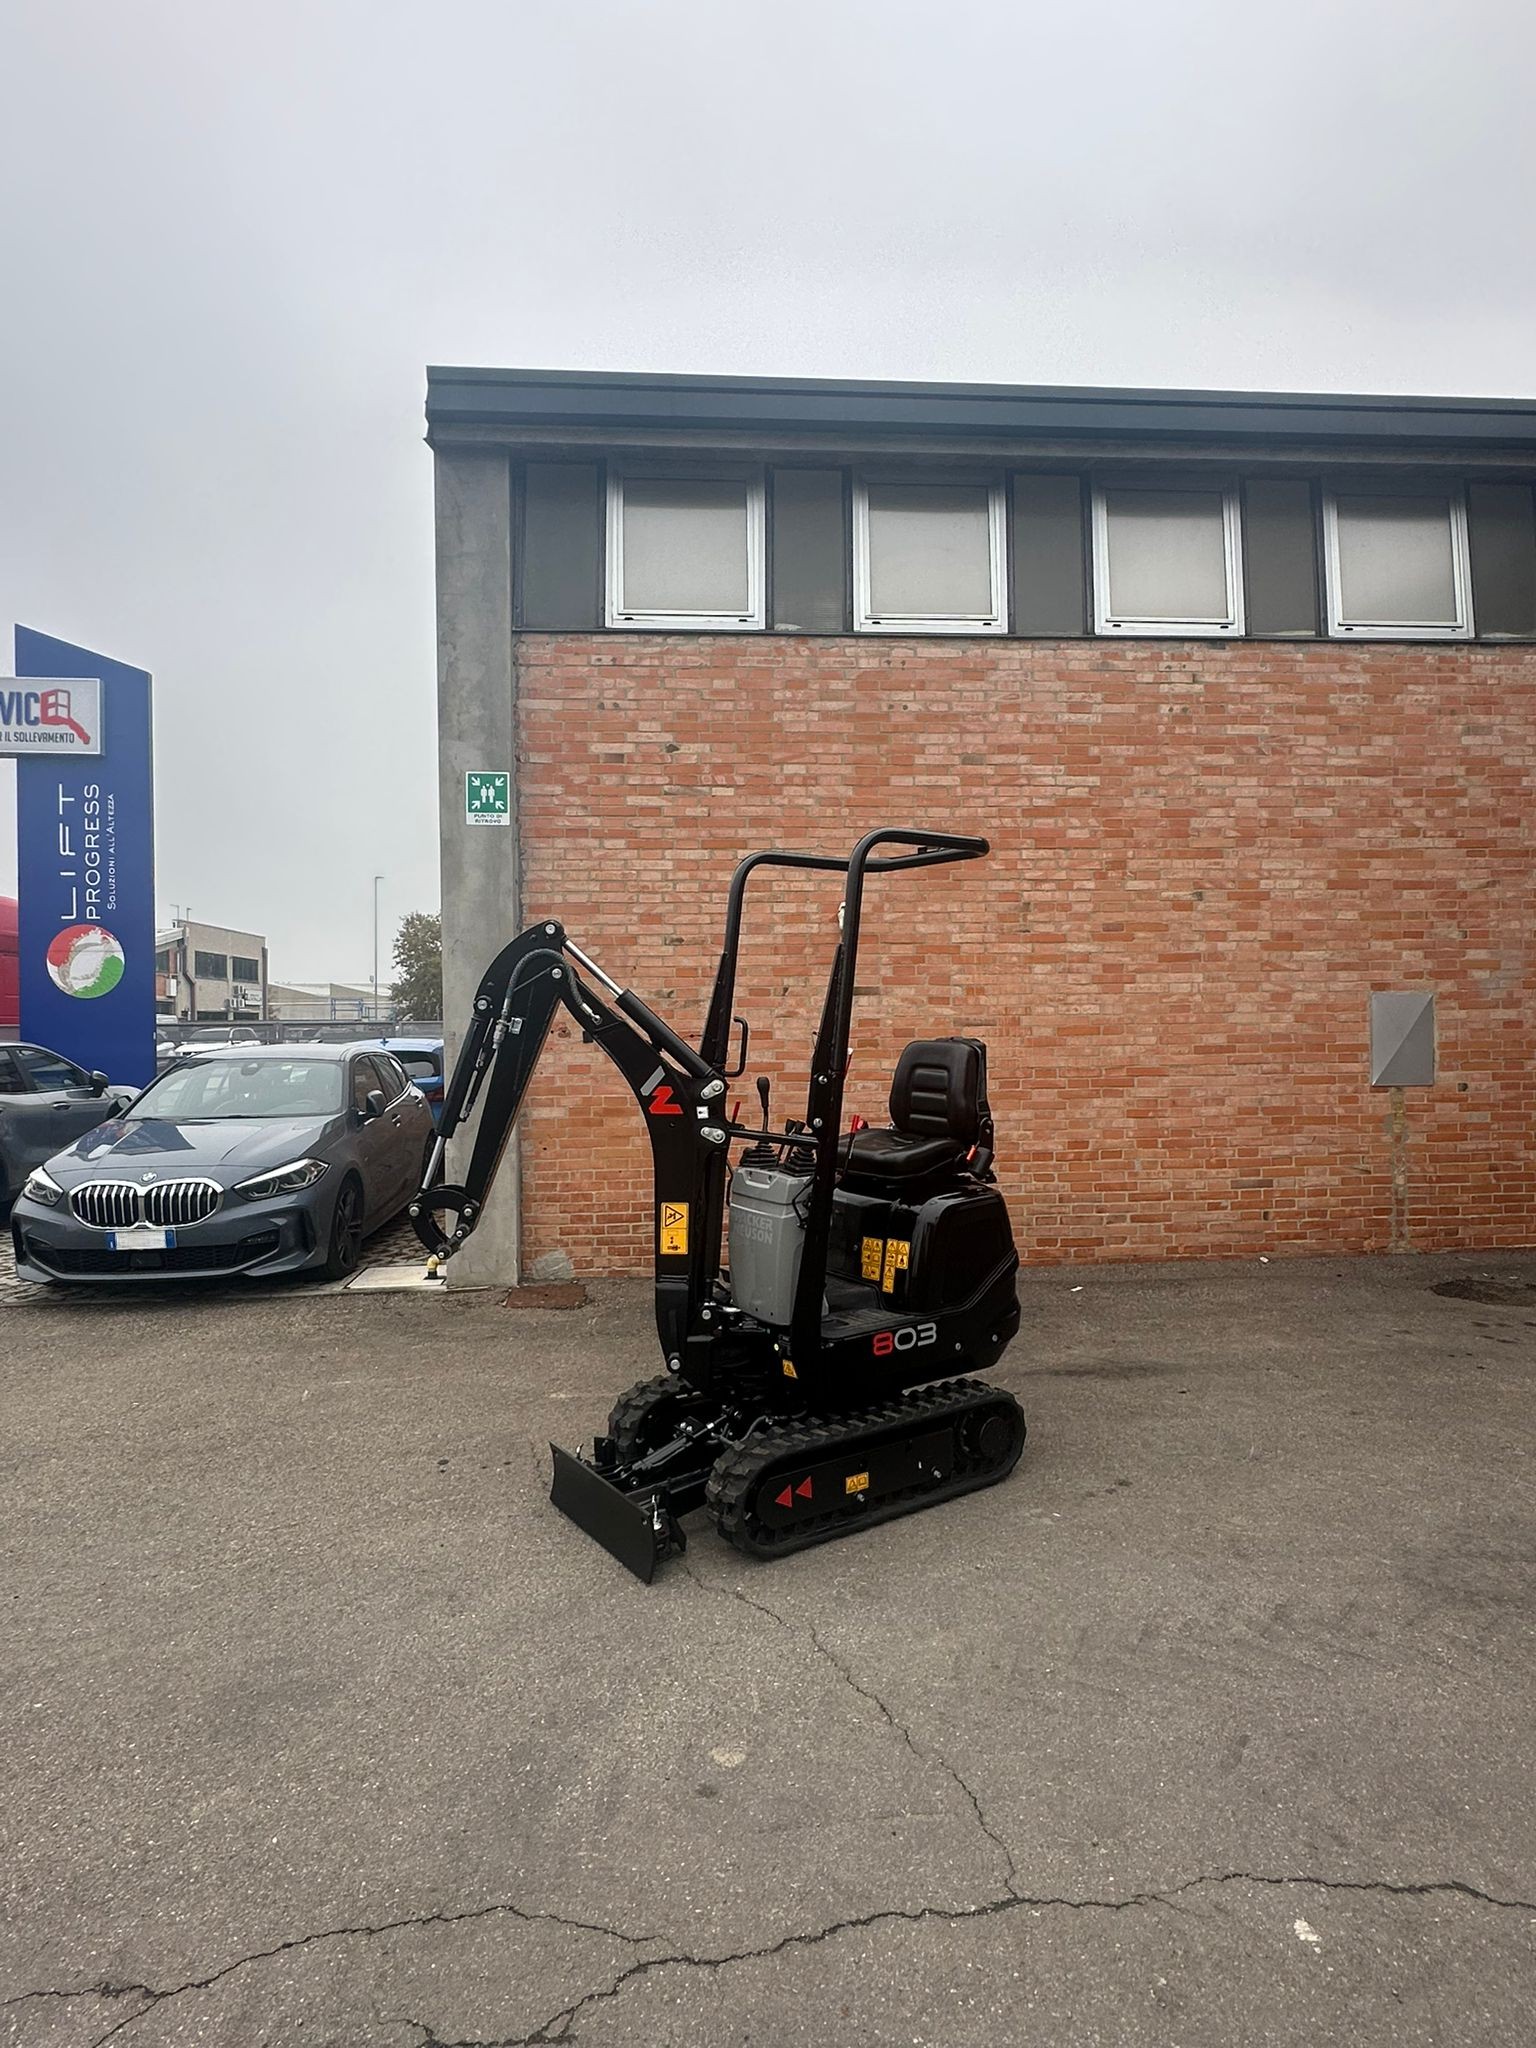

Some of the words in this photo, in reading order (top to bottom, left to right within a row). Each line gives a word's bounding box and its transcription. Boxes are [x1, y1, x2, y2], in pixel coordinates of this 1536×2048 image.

[13, 731, 75, 744] SOLLEVAMENTO
[59, 783, 76, 920] LIFT
[84, 784, 101, 920] PROGRESS
[873, 1322, 937, 1356] 803
